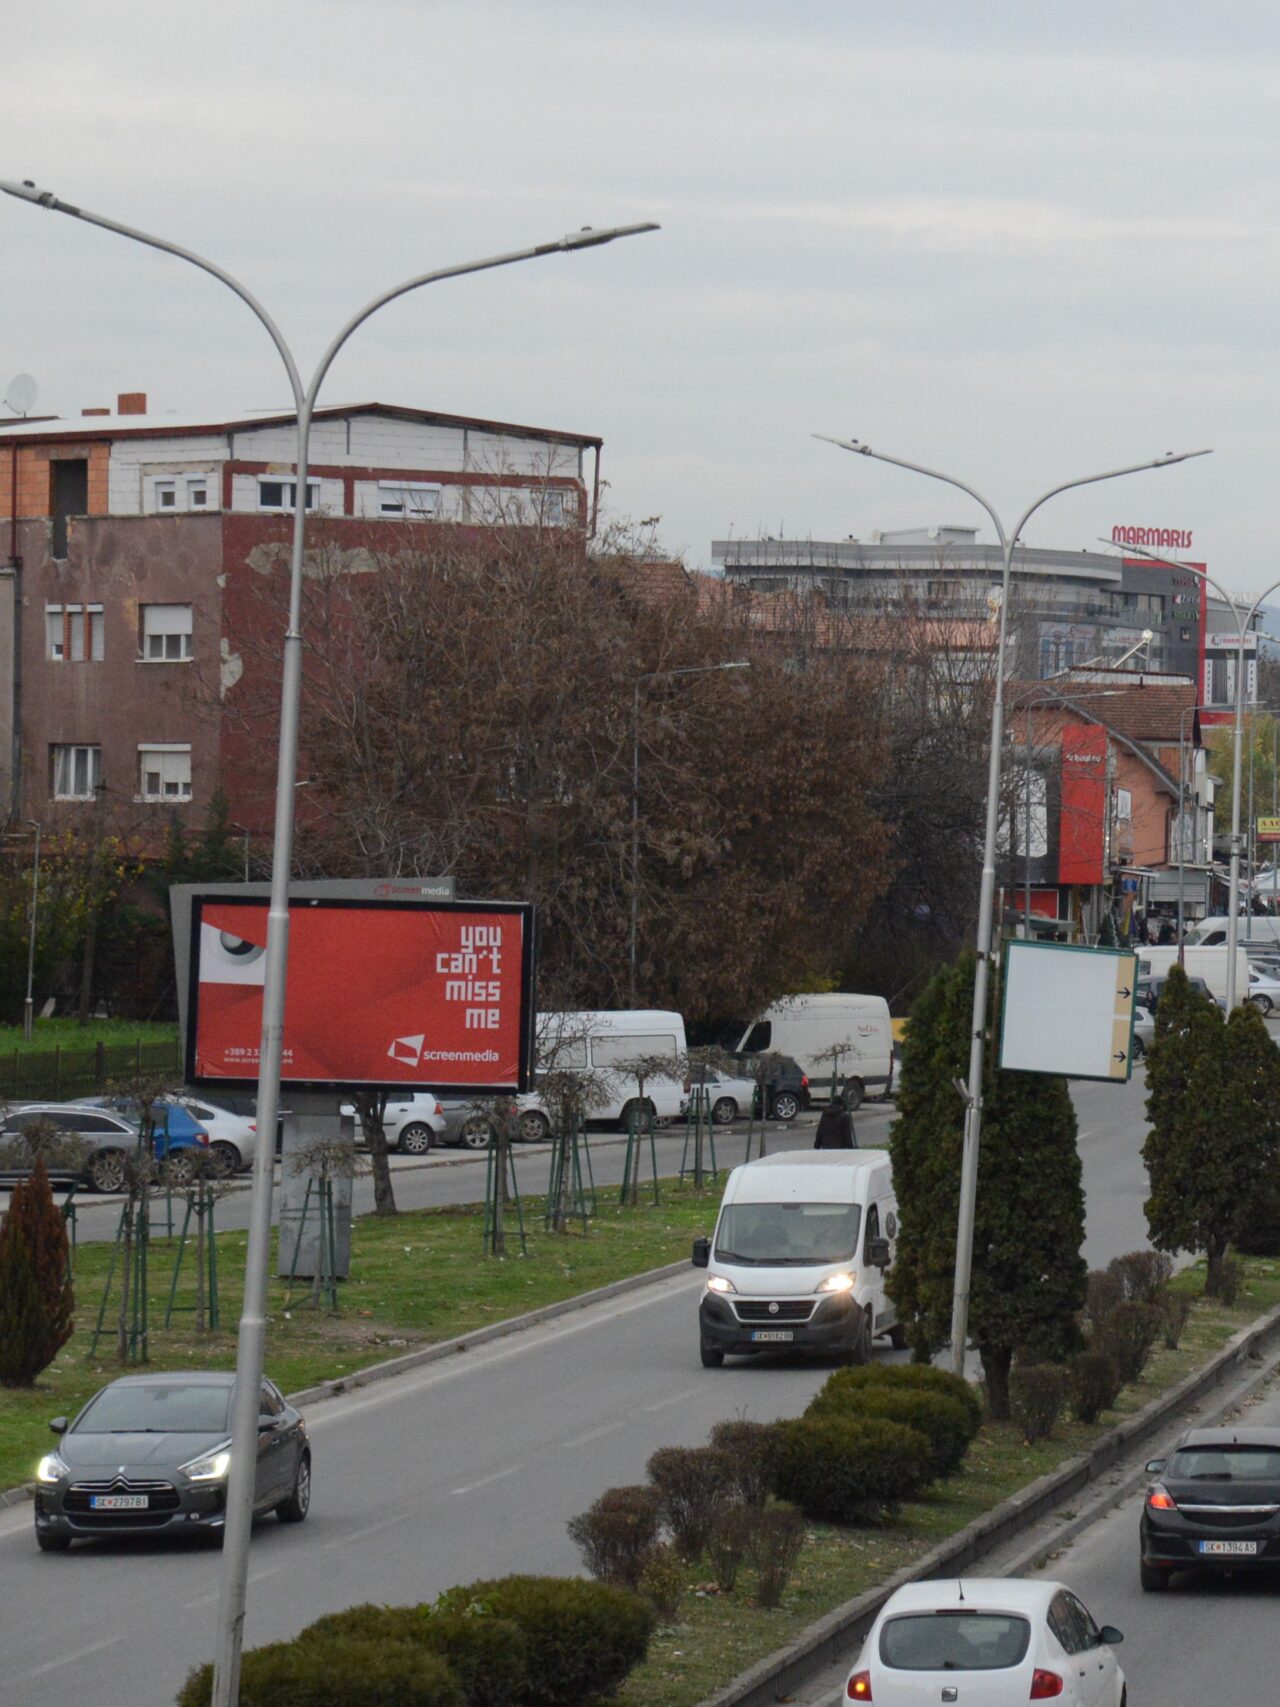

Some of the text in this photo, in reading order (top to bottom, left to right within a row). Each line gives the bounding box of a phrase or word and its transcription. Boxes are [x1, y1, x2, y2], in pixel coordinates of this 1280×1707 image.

[1112, 525, 1193, 549] MARMARIS
[461, 926, 501, 953] you
[436, 947, 501, 974] can't
[446, 975, 500, 1001] miss
[465, 1008, 500, 1029] me
[423, 1050, 499, 1062] screenmedia
